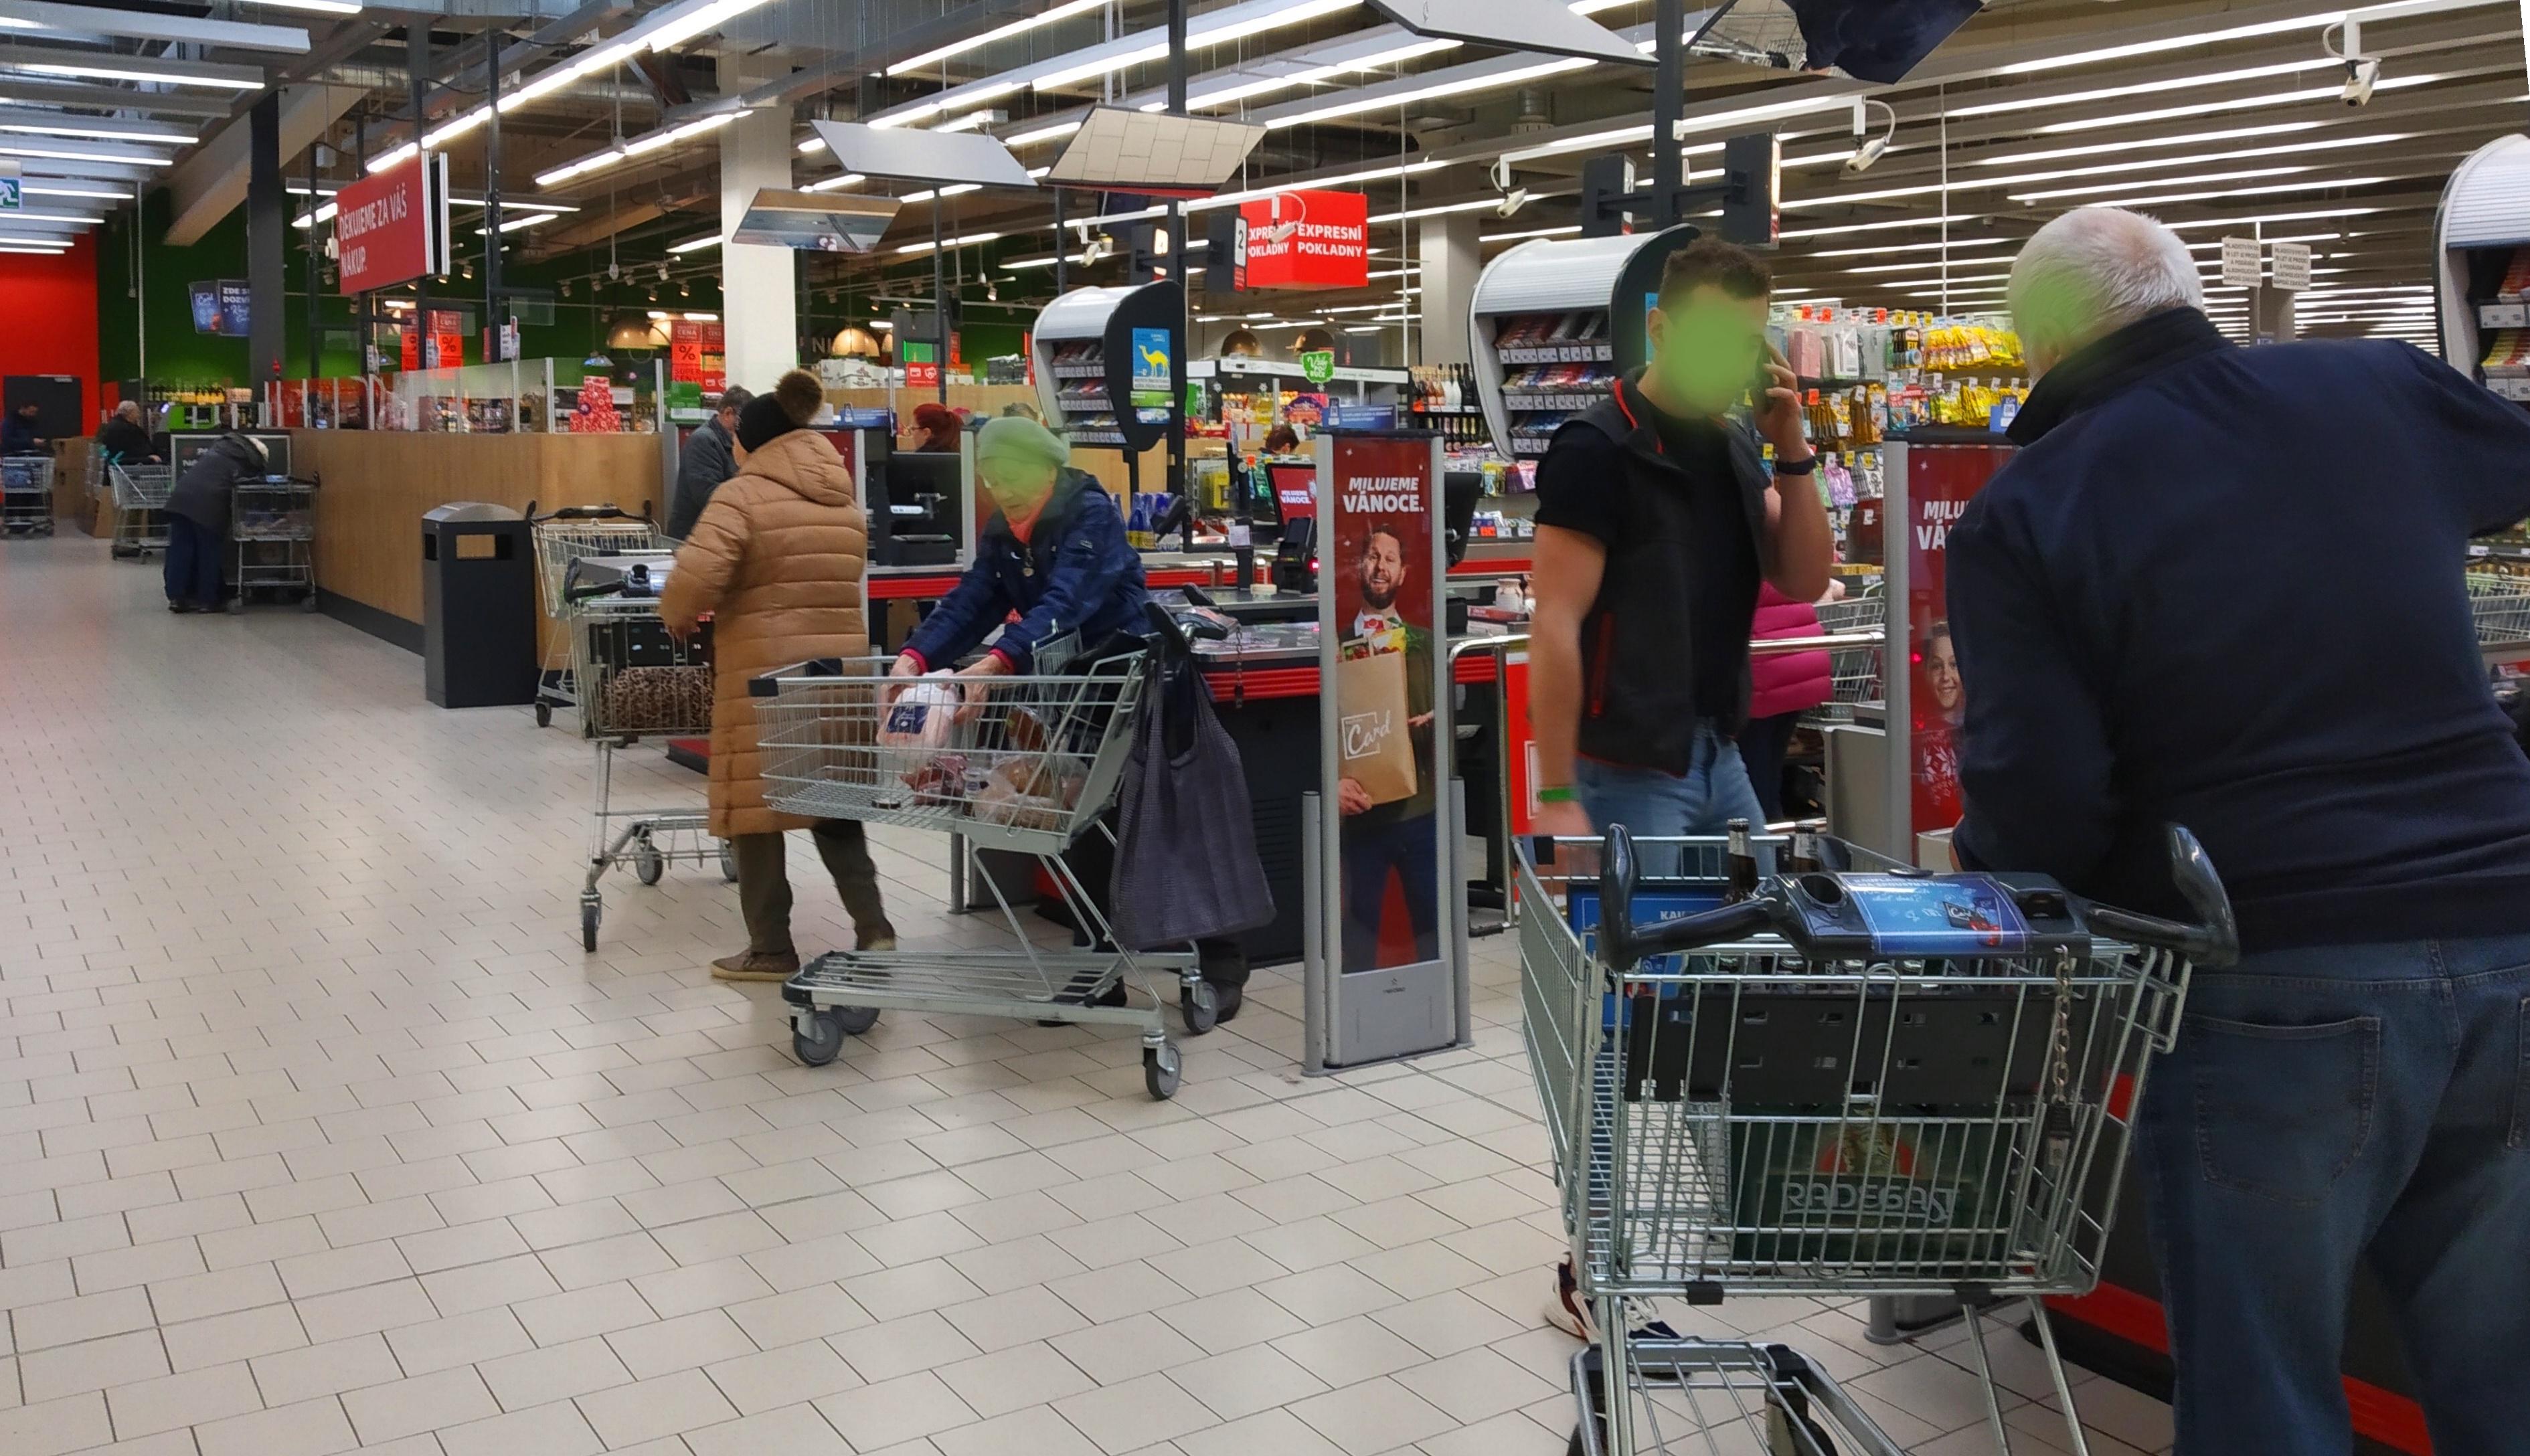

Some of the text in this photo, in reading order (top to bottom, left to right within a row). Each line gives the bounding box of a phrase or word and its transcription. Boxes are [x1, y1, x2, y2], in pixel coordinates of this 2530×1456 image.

[339, 181, 408, 242] DĚKUJEME ZA VÁŠ
[1238, 229, 1244, 250] 2
[1297, 223, 1363, 241] EXPRESNÍ
[1248, 242, 1290, 258] OKLADNY
[1297, 242, 1363, 258] POKLADNY
[340, 245, 367, 278] NÁKUP.
[1348, 476, 1420, 492] MILUJEME
[1343, 490, 1425, 513] VÁNOCE.
[1923, 500, 1970, 520] MILU
[1916, 519, 1953, 550] VÁ
[1348, 709, 1392, 755] Card
